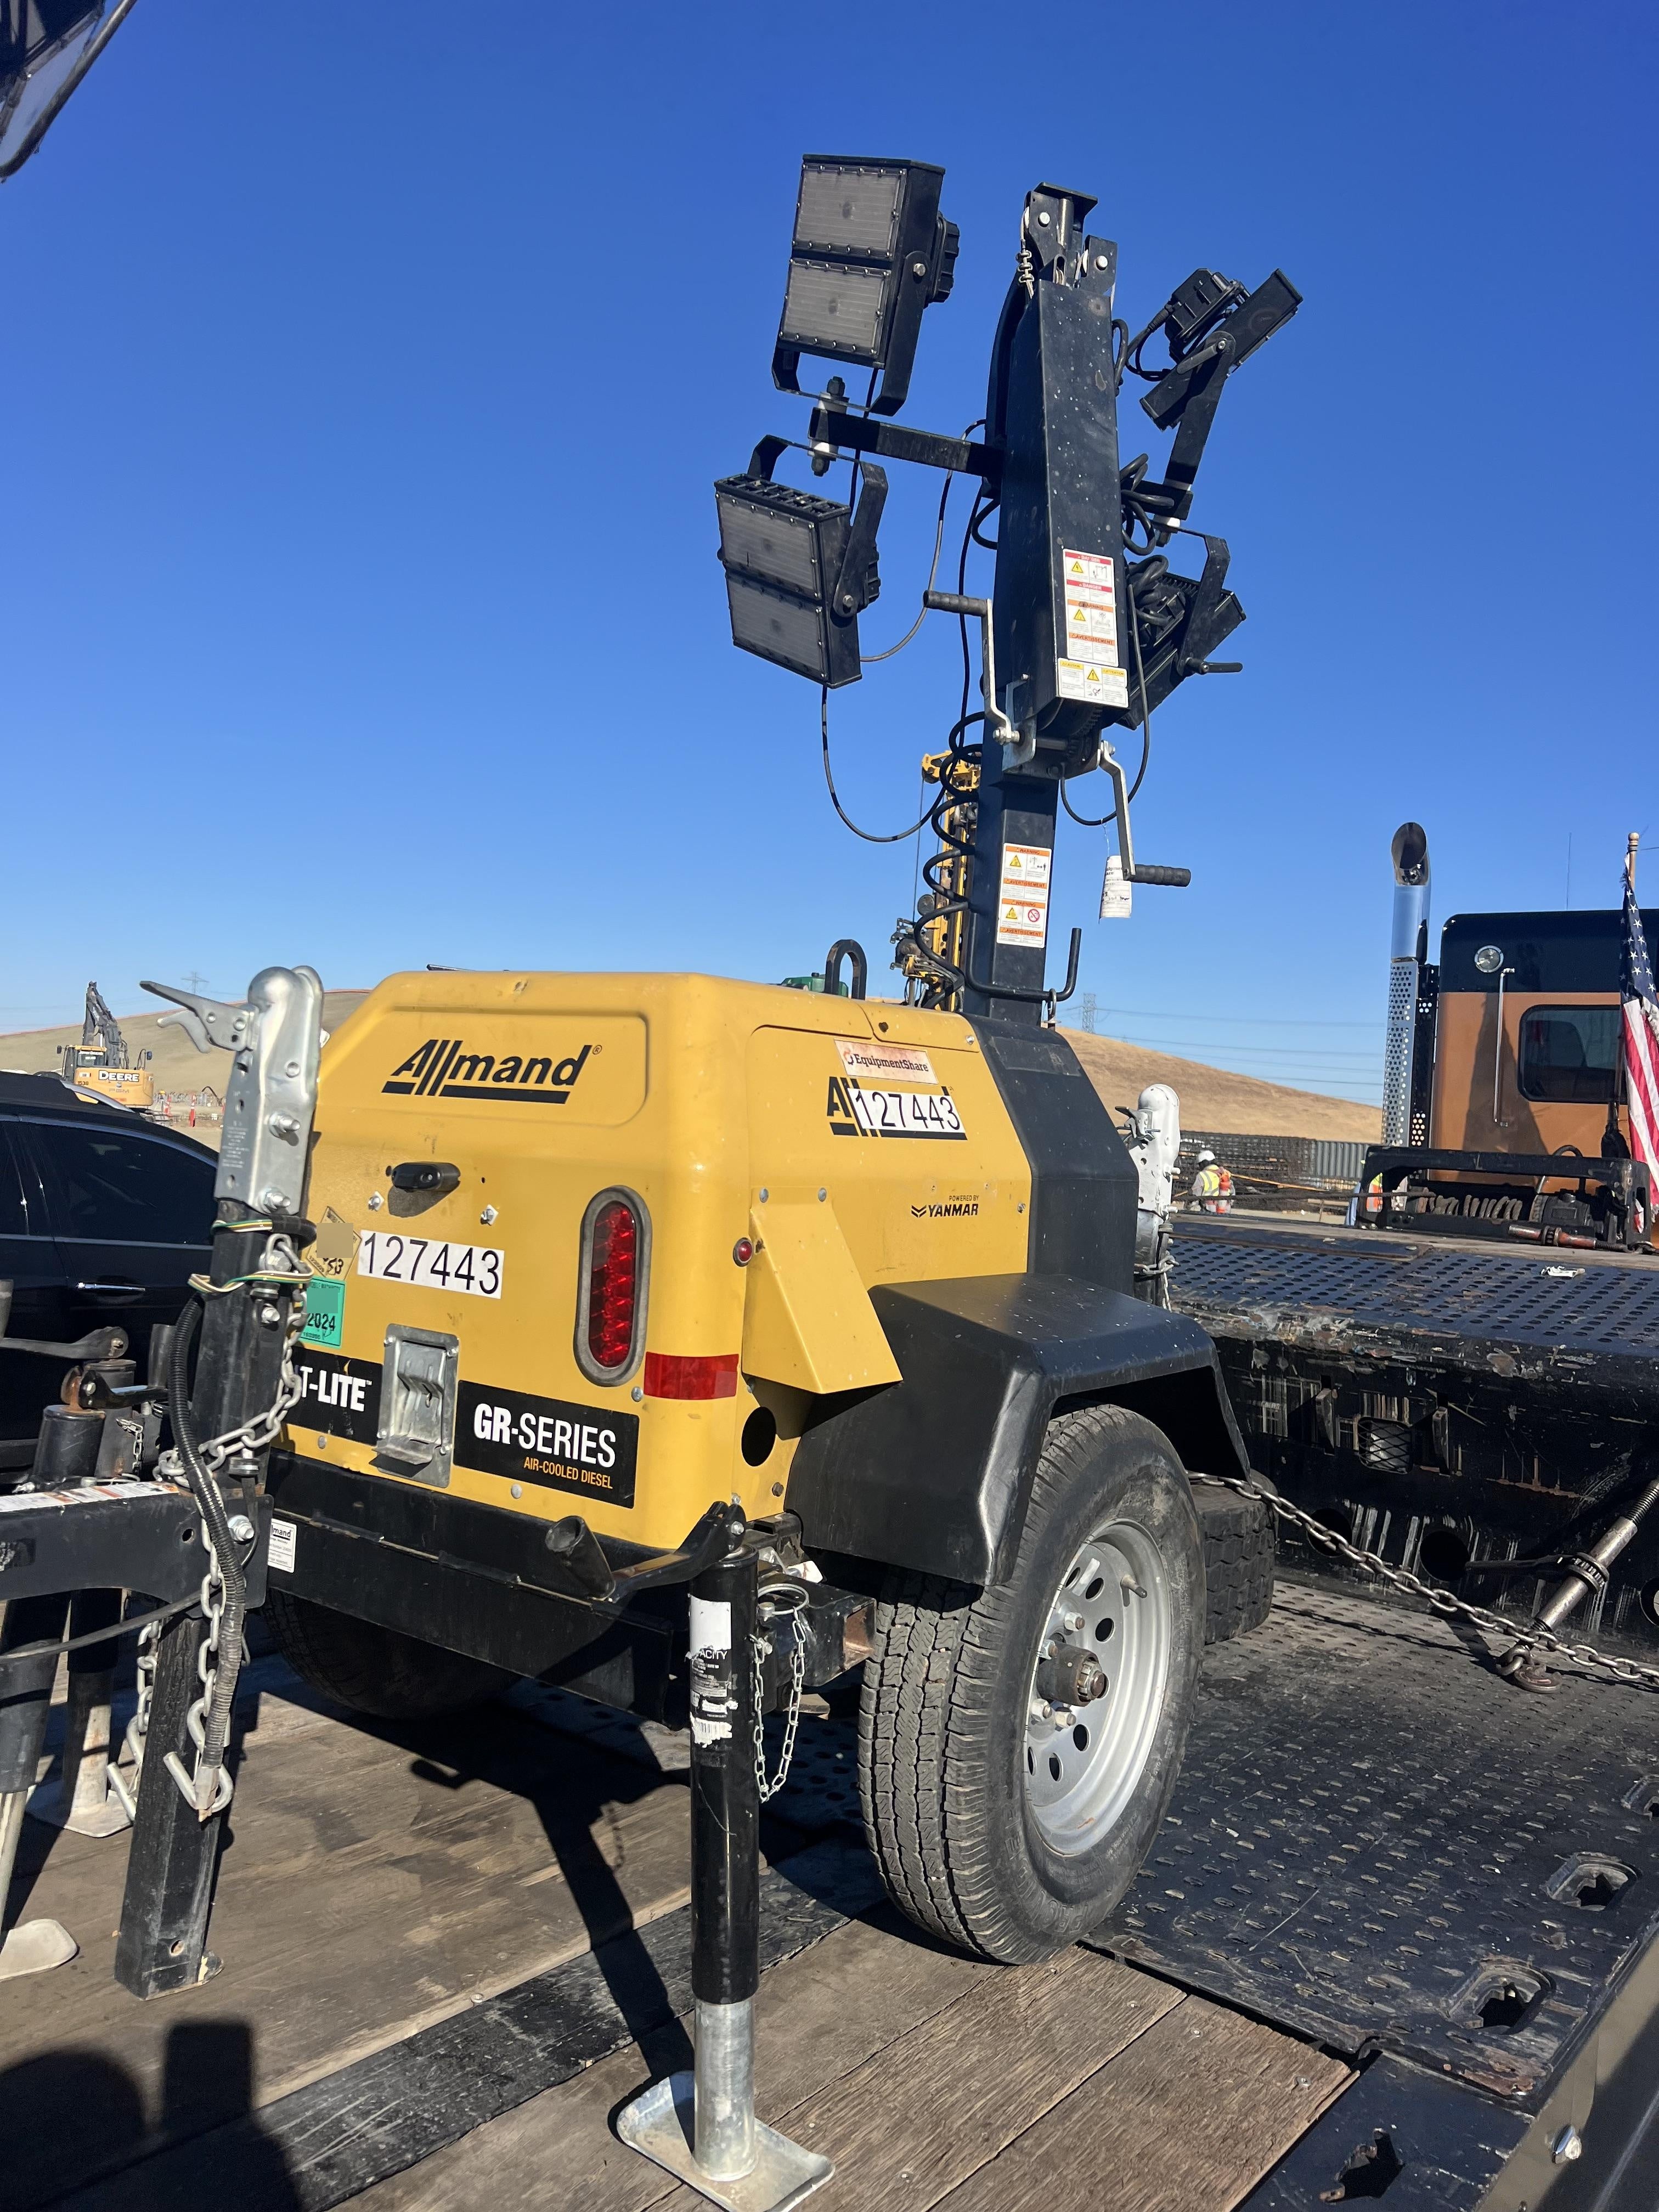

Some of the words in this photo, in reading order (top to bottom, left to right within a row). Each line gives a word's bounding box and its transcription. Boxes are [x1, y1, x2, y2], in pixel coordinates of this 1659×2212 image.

[1076, 634, 1113, 645] AVERTISSEMENT
[1009, 879, 1045, 888] AVERTISSEMENT
[1006, 928, 1041, 936] AVERTISSEMENT
[388, 1039, 593, 1097] Allmand
[854, 1053, 929, 1072] EquipmentShare
[99, 1070, 140, 1082] DEERE
[855, 1090, 960, 1130] 127443
[928, 1203, 979, 1217] YANMAR
[364, 1232, 500, 1295] 127443
[307, 1313, 336, 1331] 2024
[300, 1365, 365, 1412] T-LITE
[473, 1403, 617, 1468] GR-SERIES
[523, 1457, 579, 1481] AIR-COOLED
[580, 1470, 614, 1489] DIESEL
[699, 1649, 728, 1660] ACITY
